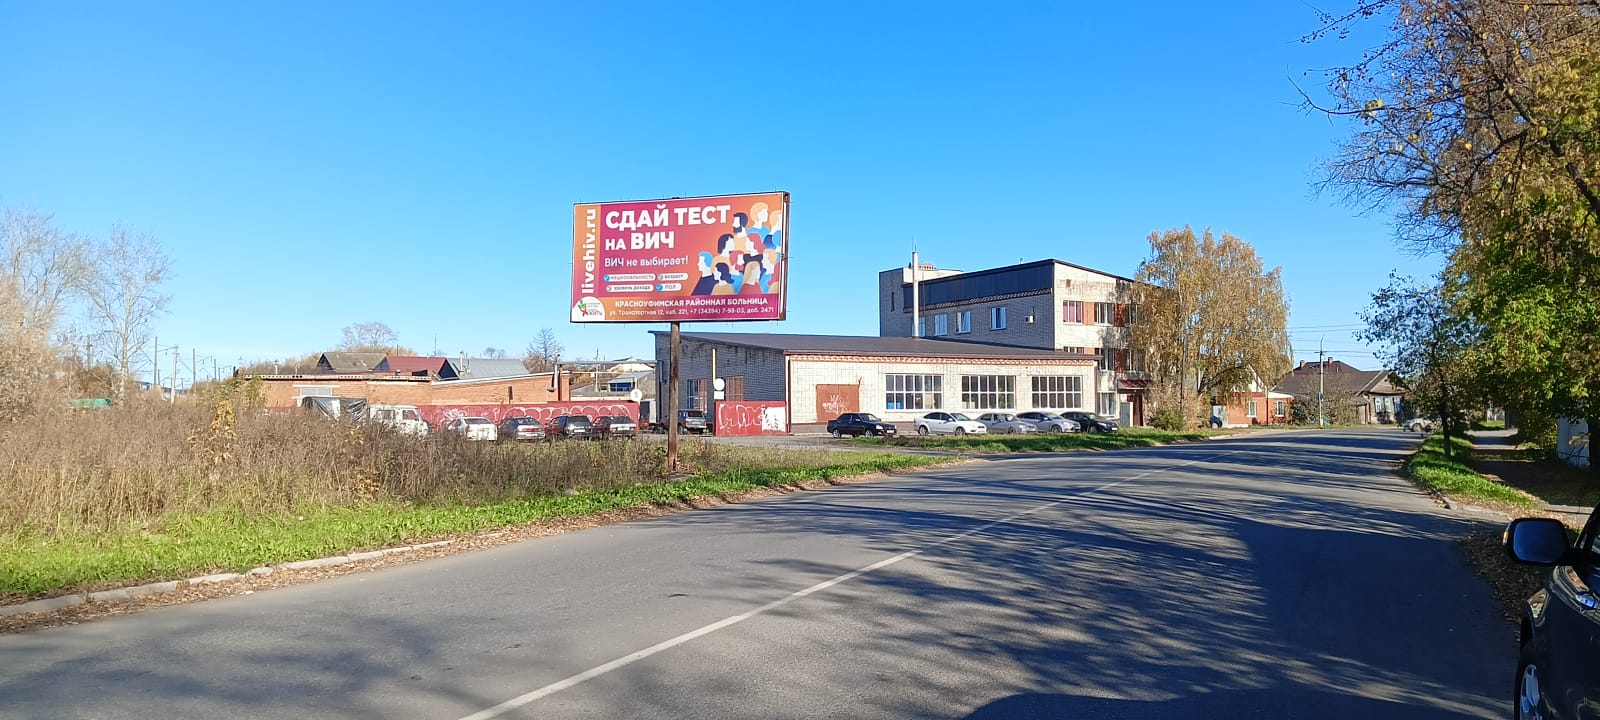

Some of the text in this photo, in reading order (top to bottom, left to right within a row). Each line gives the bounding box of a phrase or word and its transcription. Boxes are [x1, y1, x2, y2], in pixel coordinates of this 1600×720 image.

[605, 203, 731, 231] СДАЙ ТЕСТ
[630, 230, 675, 250] ВИЧ
[581, 208, 597, 294] livehiv.ru
[604, 256, 689, 267] ВИЧ не выбирает!
[615, 297, 768, 308] КРАСНОУФИМСКАЯ РАЙОННАЯ БОЛЬНИЦА
